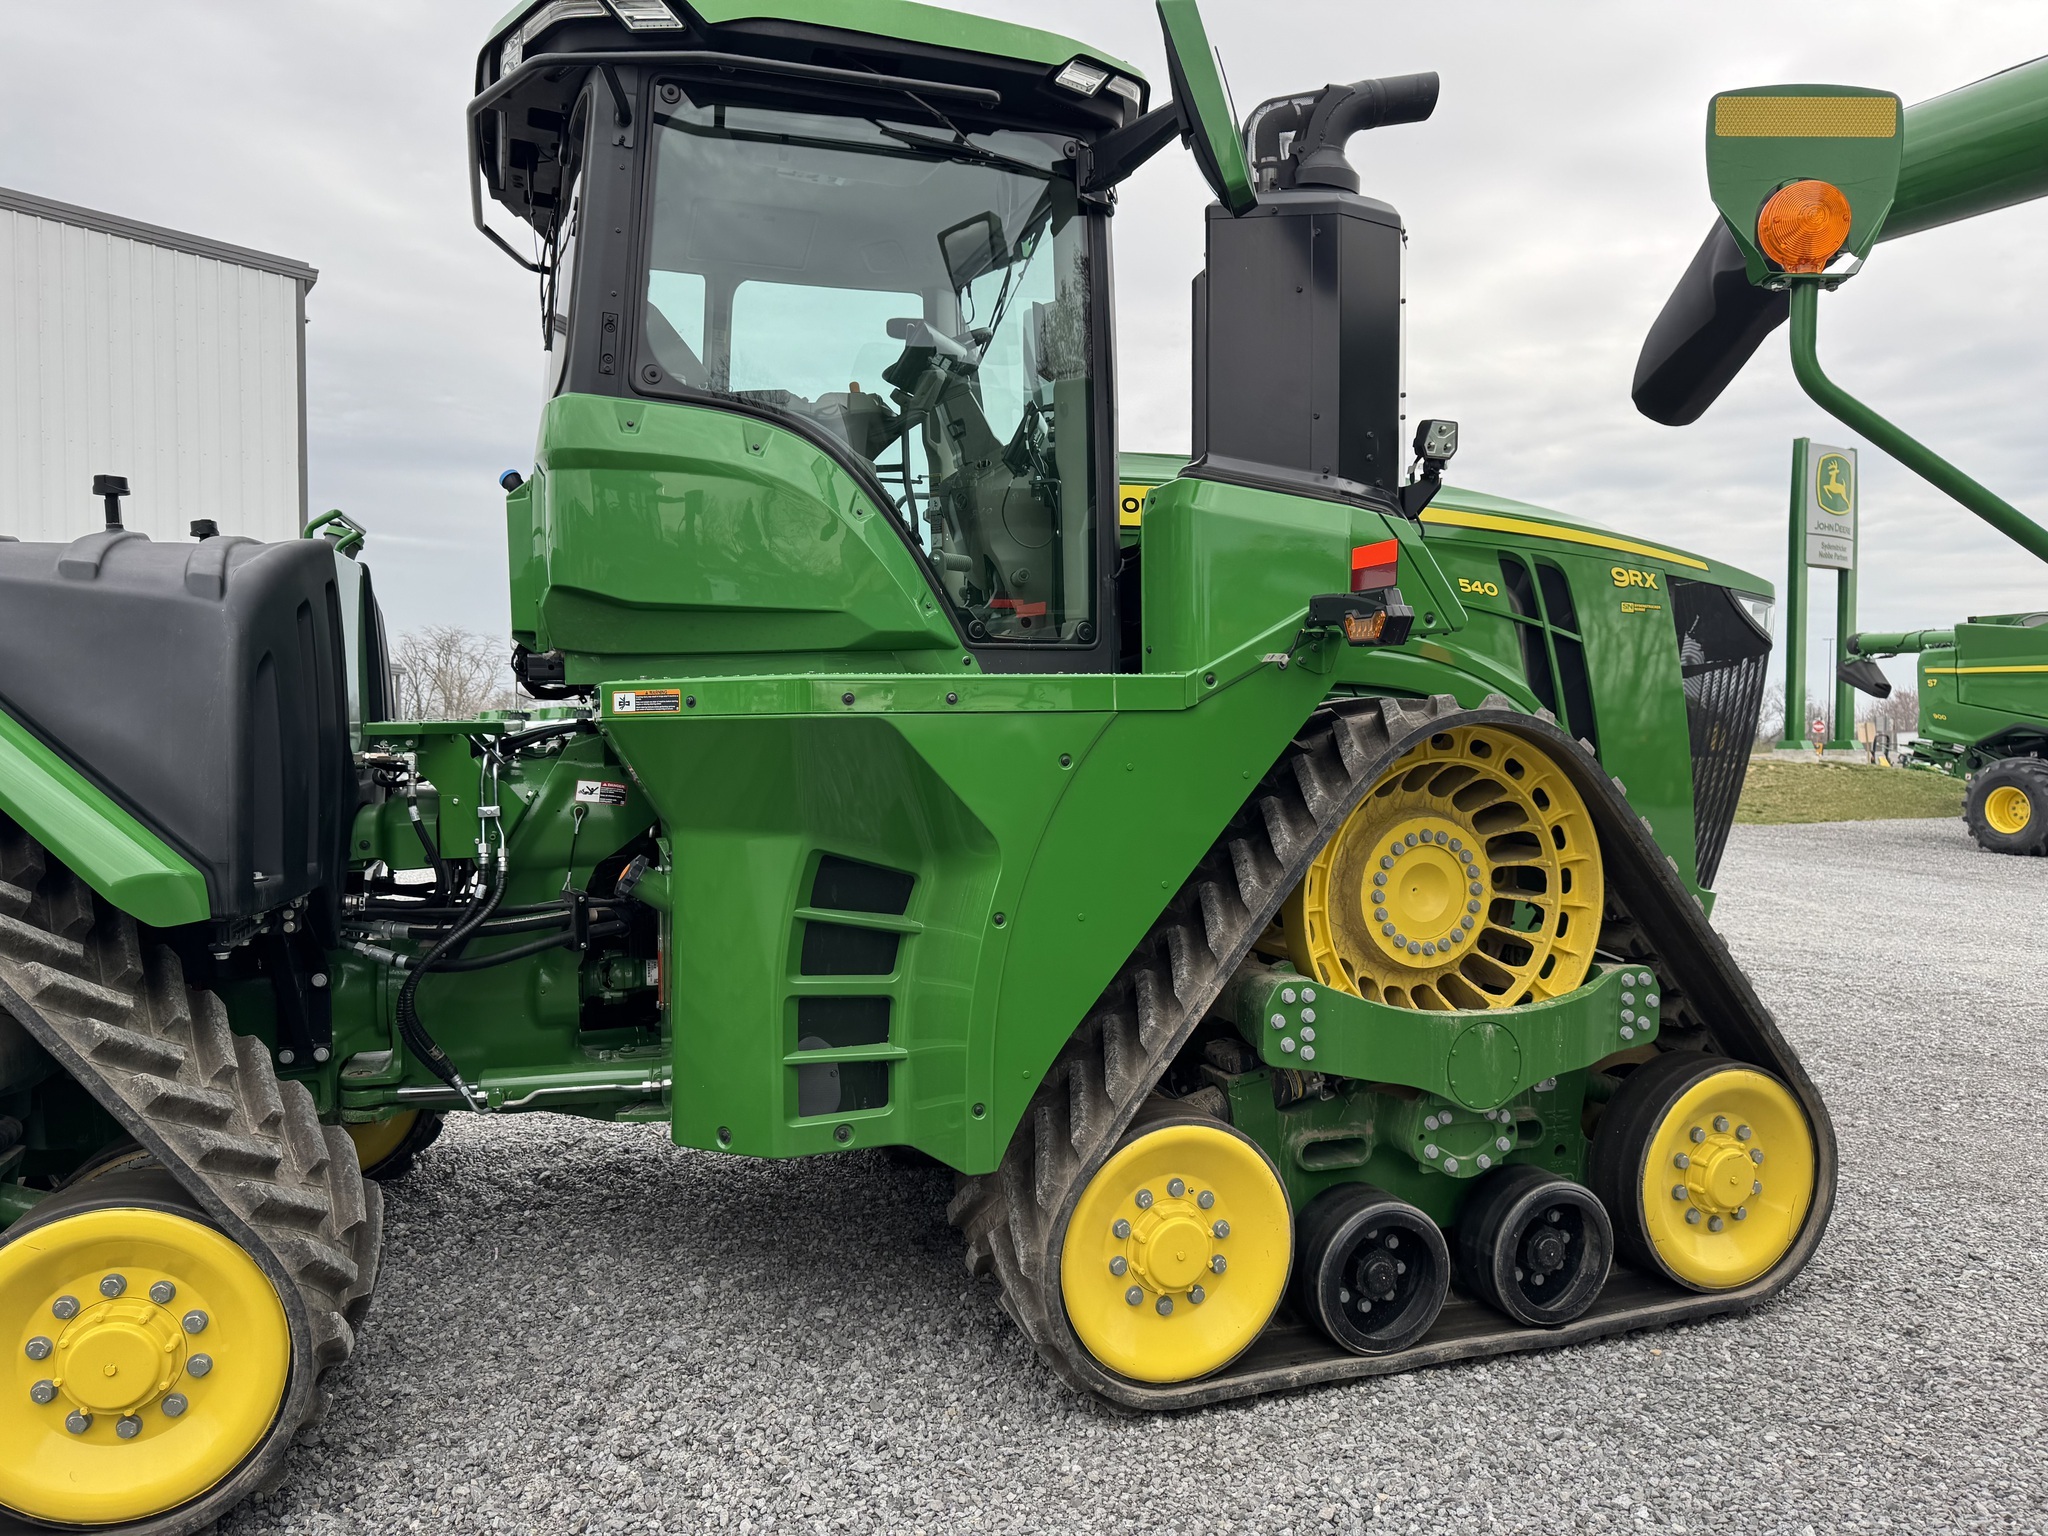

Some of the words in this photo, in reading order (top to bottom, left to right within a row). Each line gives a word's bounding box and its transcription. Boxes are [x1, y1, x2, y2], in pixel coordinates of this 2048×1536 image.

[1814, 520, 1834, 532] JOHN
[1834, 522, 1851, 536] DEERE
[1610, 566, 1660, 591] 9RX
[1458, 578, 1499, 597] 540
[1927, 678, 1937, 688] S7
